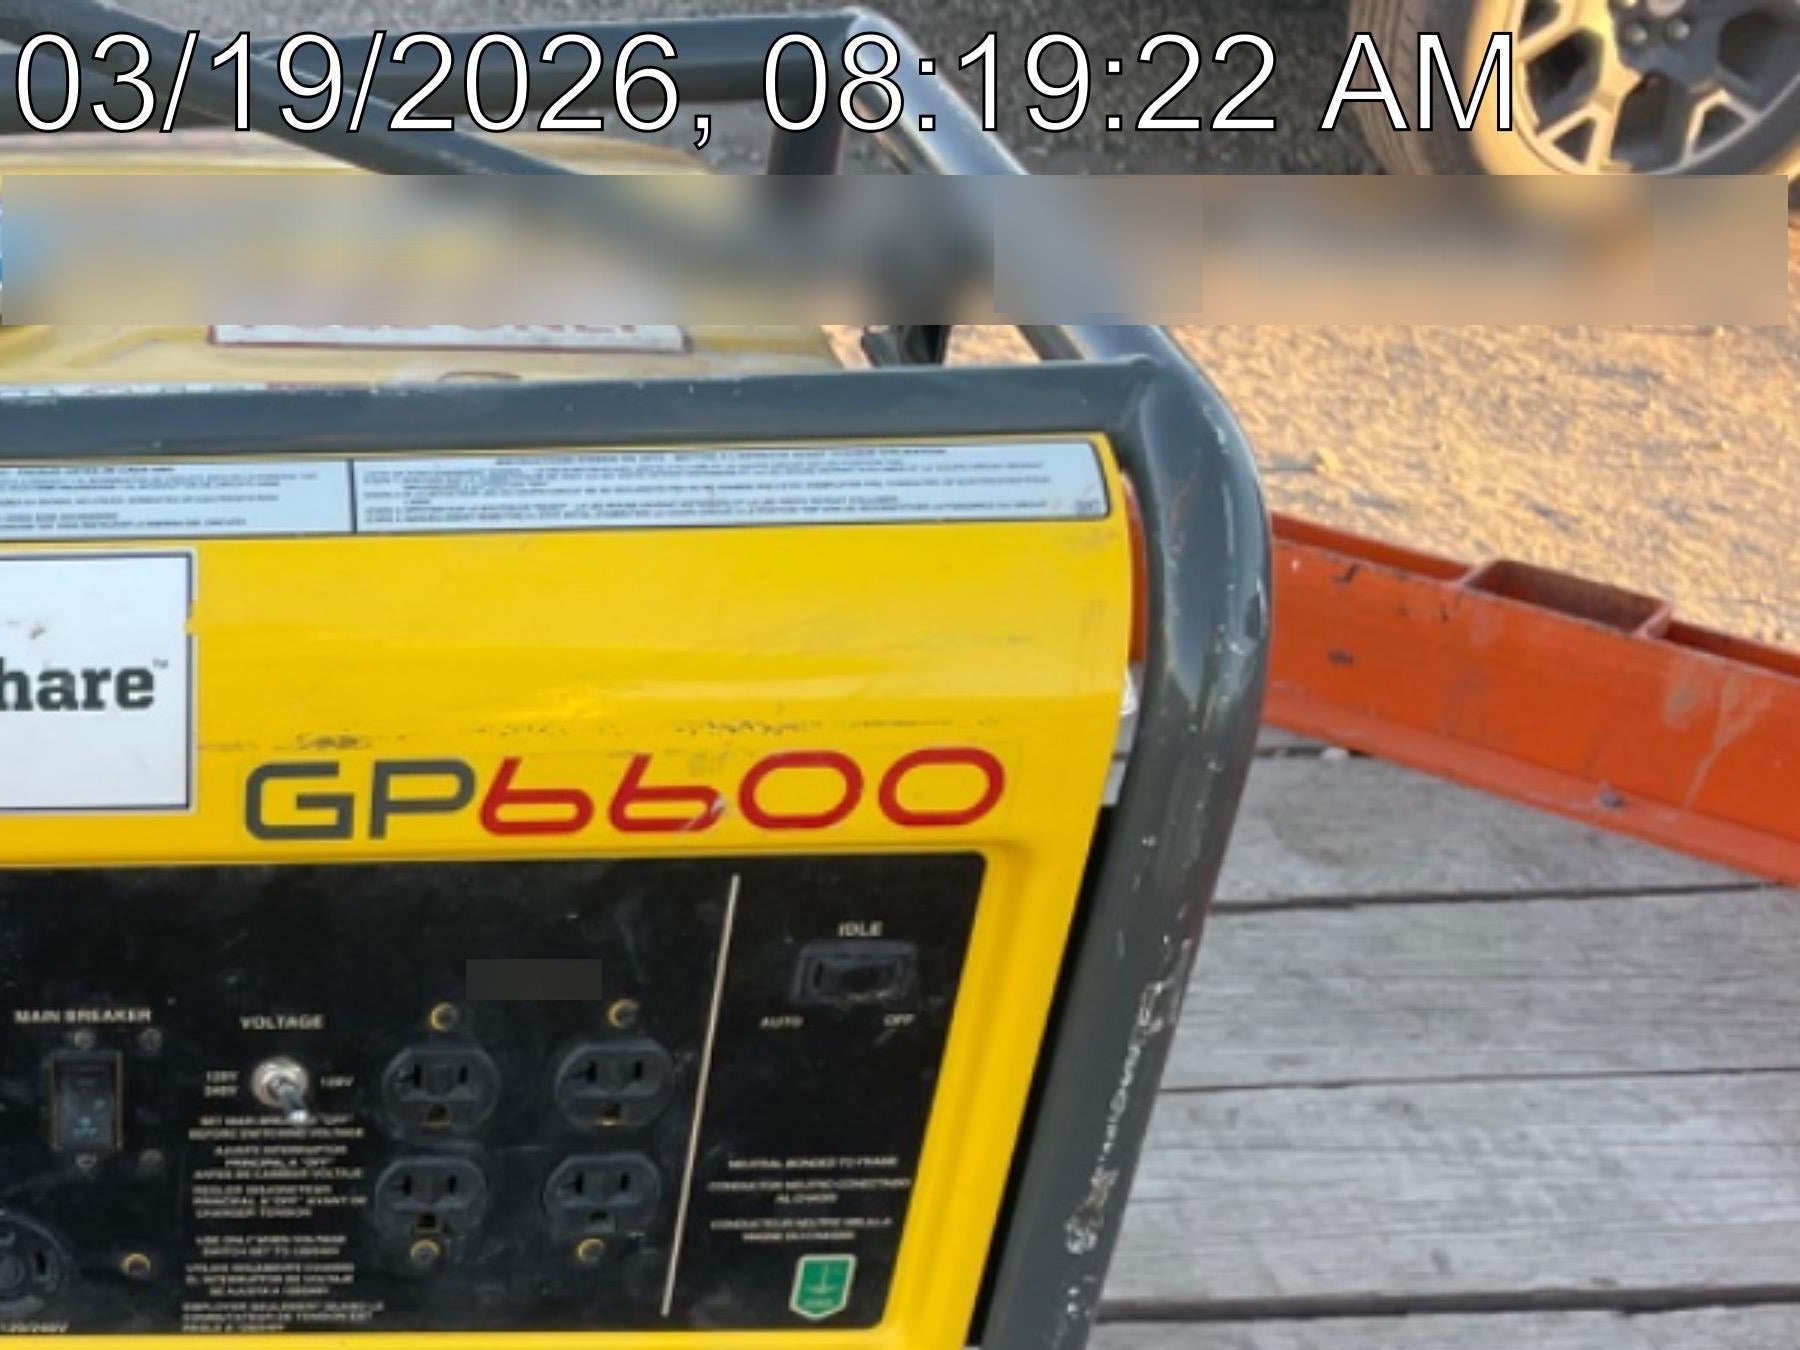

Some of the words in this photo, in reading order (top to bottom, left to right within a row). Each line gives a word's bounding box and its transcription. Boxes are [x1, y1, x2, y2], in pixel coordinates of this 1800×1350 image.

[245, 747, 1006, 841] GP6600
[837, 922, 883, 938] IDLE
[14, 1010, 61, 1024] MAIN
[64, 1009, 152, 1024] BREAKER
[240, 1014, 325, 1030] VOLTAGE
[760, 1016, 803, 1028] AUTO
[884, 1014, 916, 1026] OFF
